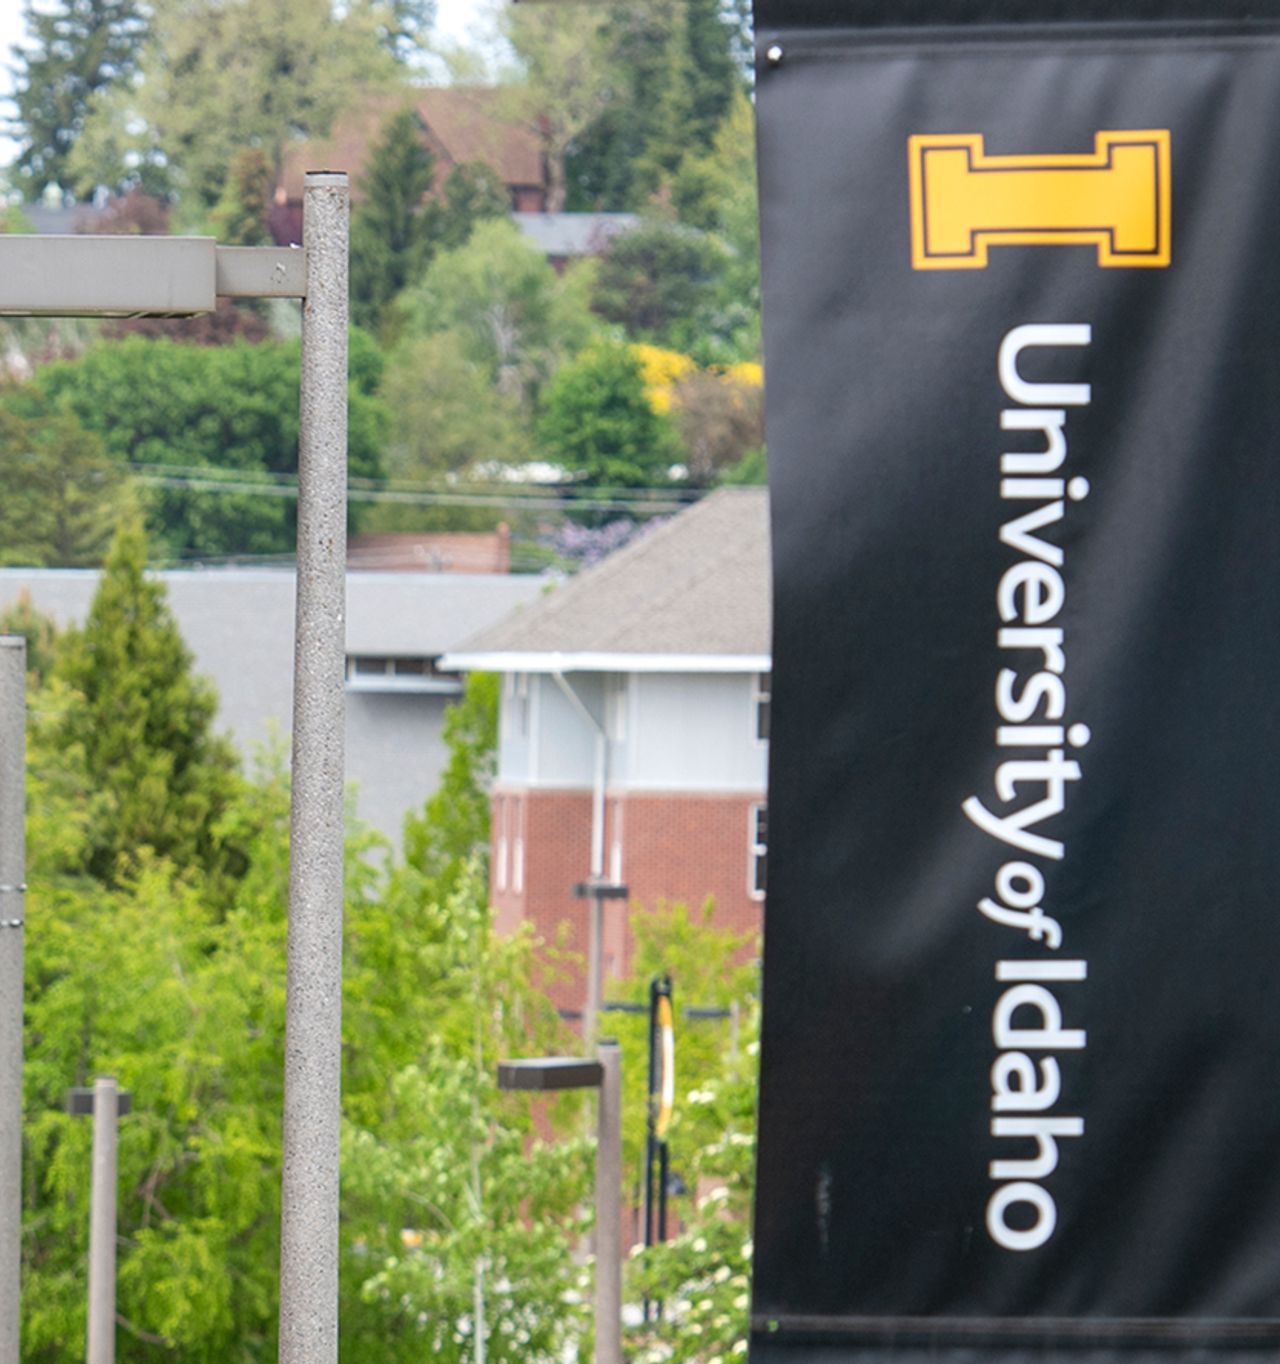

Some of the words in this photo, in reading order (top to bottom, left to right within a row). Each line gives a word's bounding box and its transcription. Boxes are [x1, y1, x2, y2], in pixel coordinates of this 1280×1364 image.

[908, 129, 1172, 270] I
[964, 322, 1092, 860] University
[979, 862, 1062, 948] of
[988, 960, 1088, 1250] Idaho
